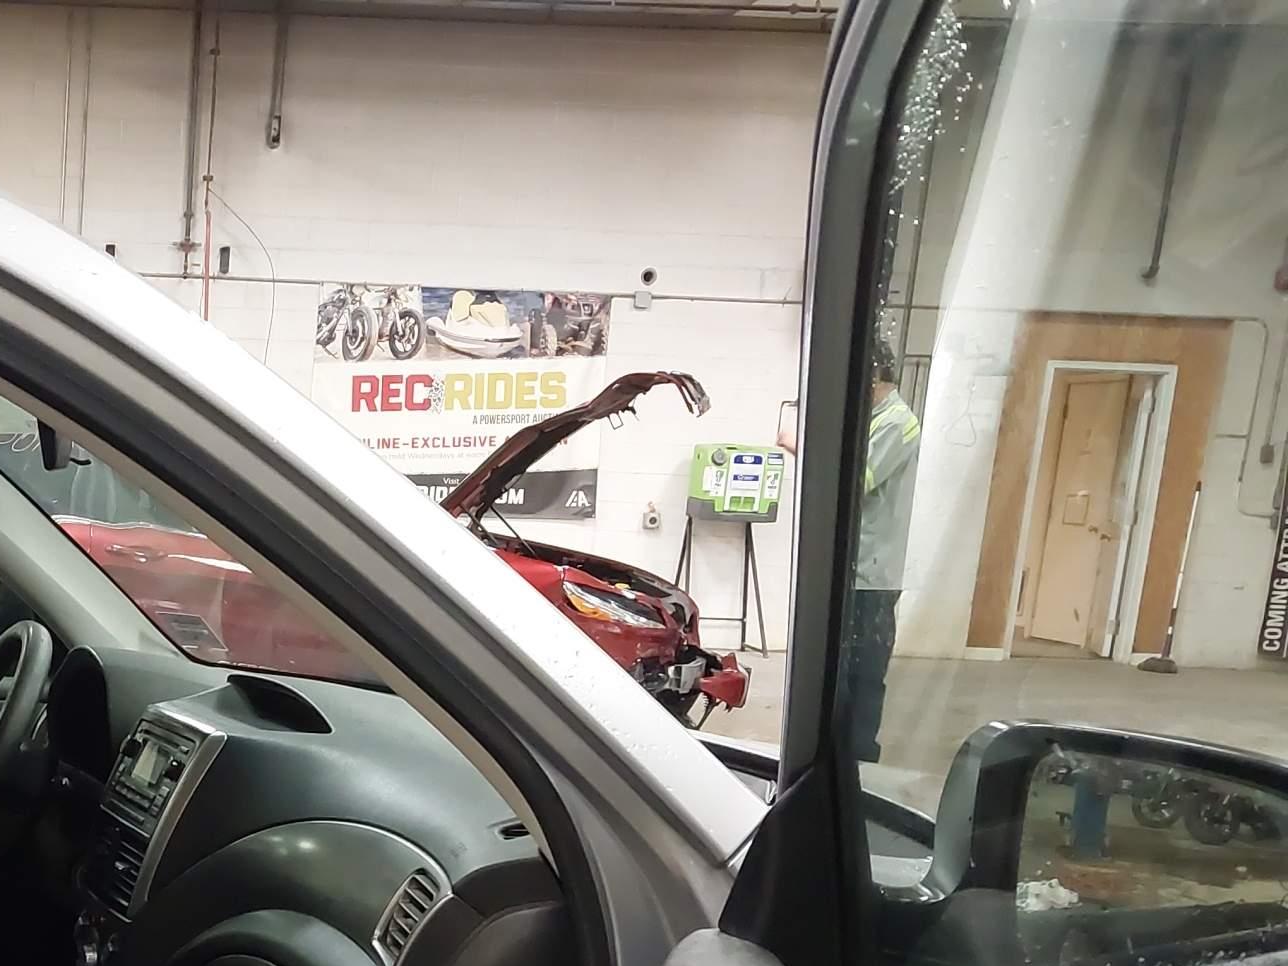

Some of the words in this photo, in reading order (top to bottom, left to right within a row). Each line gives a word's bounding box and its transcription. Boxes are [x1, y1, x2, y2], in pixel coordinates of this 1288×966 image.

[351, 374, 434, 413] REC
[444, 371, 568, 411] RIDES
[472, 415, 479, 425] A
[479, 414, 530, 425] POWERSPORT
[362, 436, 497, 449] LINE-EXCLUSIVE
[442, 477, 460, 485] Visit
[1262, 577, 1288, 652] COMING
